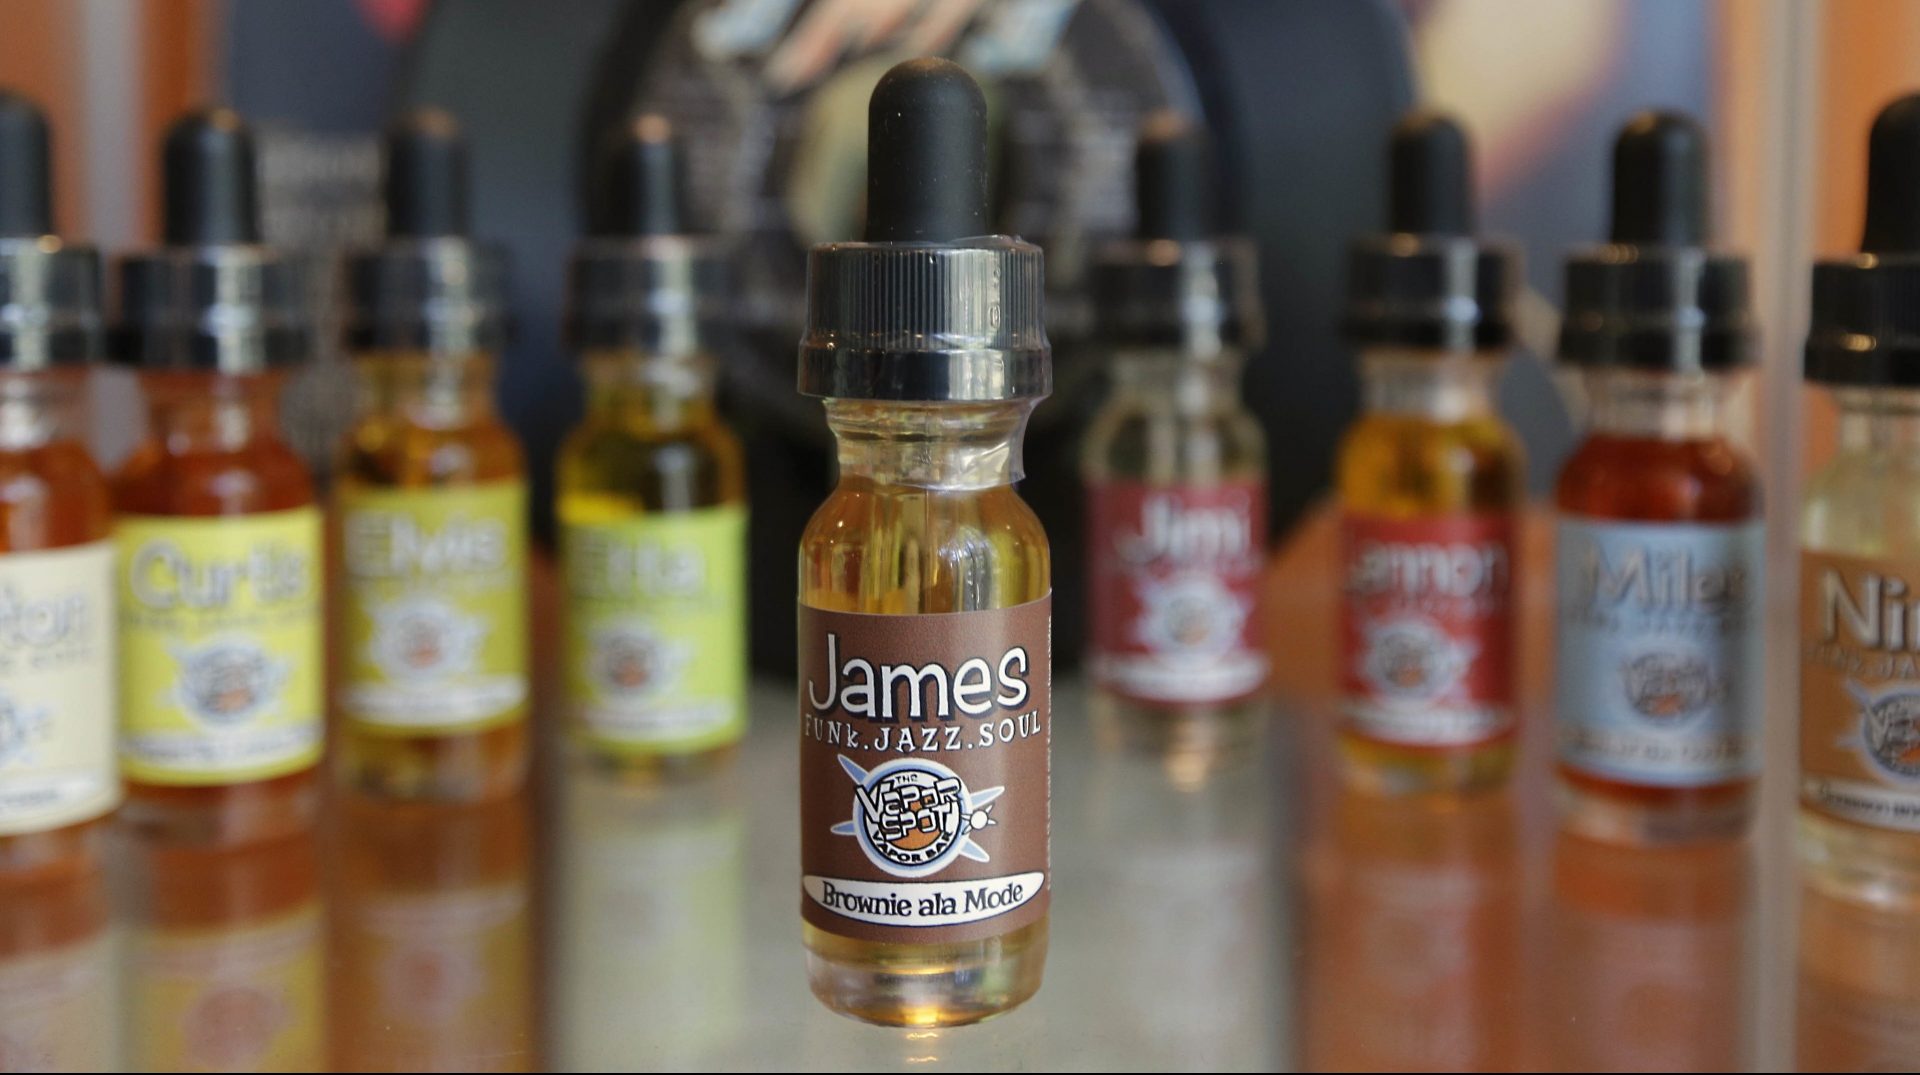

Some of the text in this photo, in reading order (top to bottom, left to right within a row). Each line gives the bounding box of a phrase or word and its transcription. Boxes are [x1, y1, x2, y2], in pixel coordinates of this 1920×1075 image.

[808, 633, 1030, 720] James
[879, 802, 953, 842] SPOT
[872, 830, 955, 864] VAPOR BAR
[822, 880, 1024, 917] Brownie ala Mode
